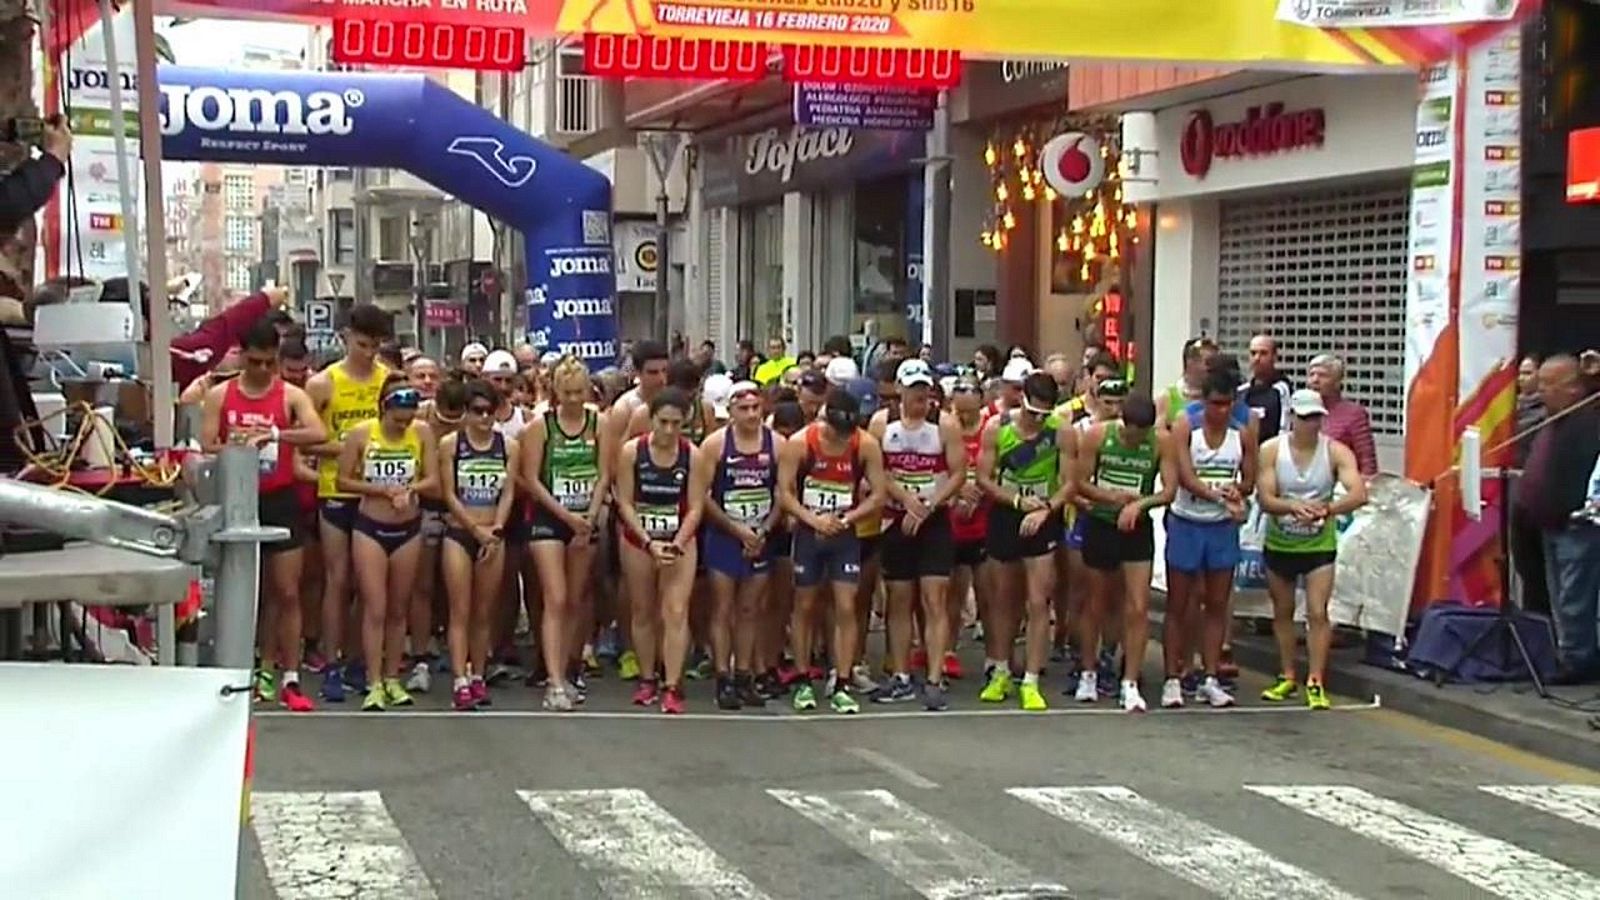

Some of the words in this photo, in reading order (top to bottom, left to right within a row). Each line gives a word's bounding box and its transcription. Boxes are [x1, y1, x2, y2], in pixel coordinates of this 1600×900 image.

[441, 0, 469, 10] EN
[476, 0, 528, 14] RUTA
[907, 0, 975, 12] Sub16
[656, 5, 749, 27] TORREVIEJA
[754, 14, 774, 29] 16
[776, 15, 847, 31] FEBRERO
[851, 17, 891, 32] 2020
[310, 304, 329, 327] P
[374, 461, 406, 476] 105
[469, 474, 498, 488] 112
[563, 480, 588, 495] 101
[819, 493, 837, 507] 14
[740, 504, 759, 518] 13
[641, 515, 668, 531] 111
